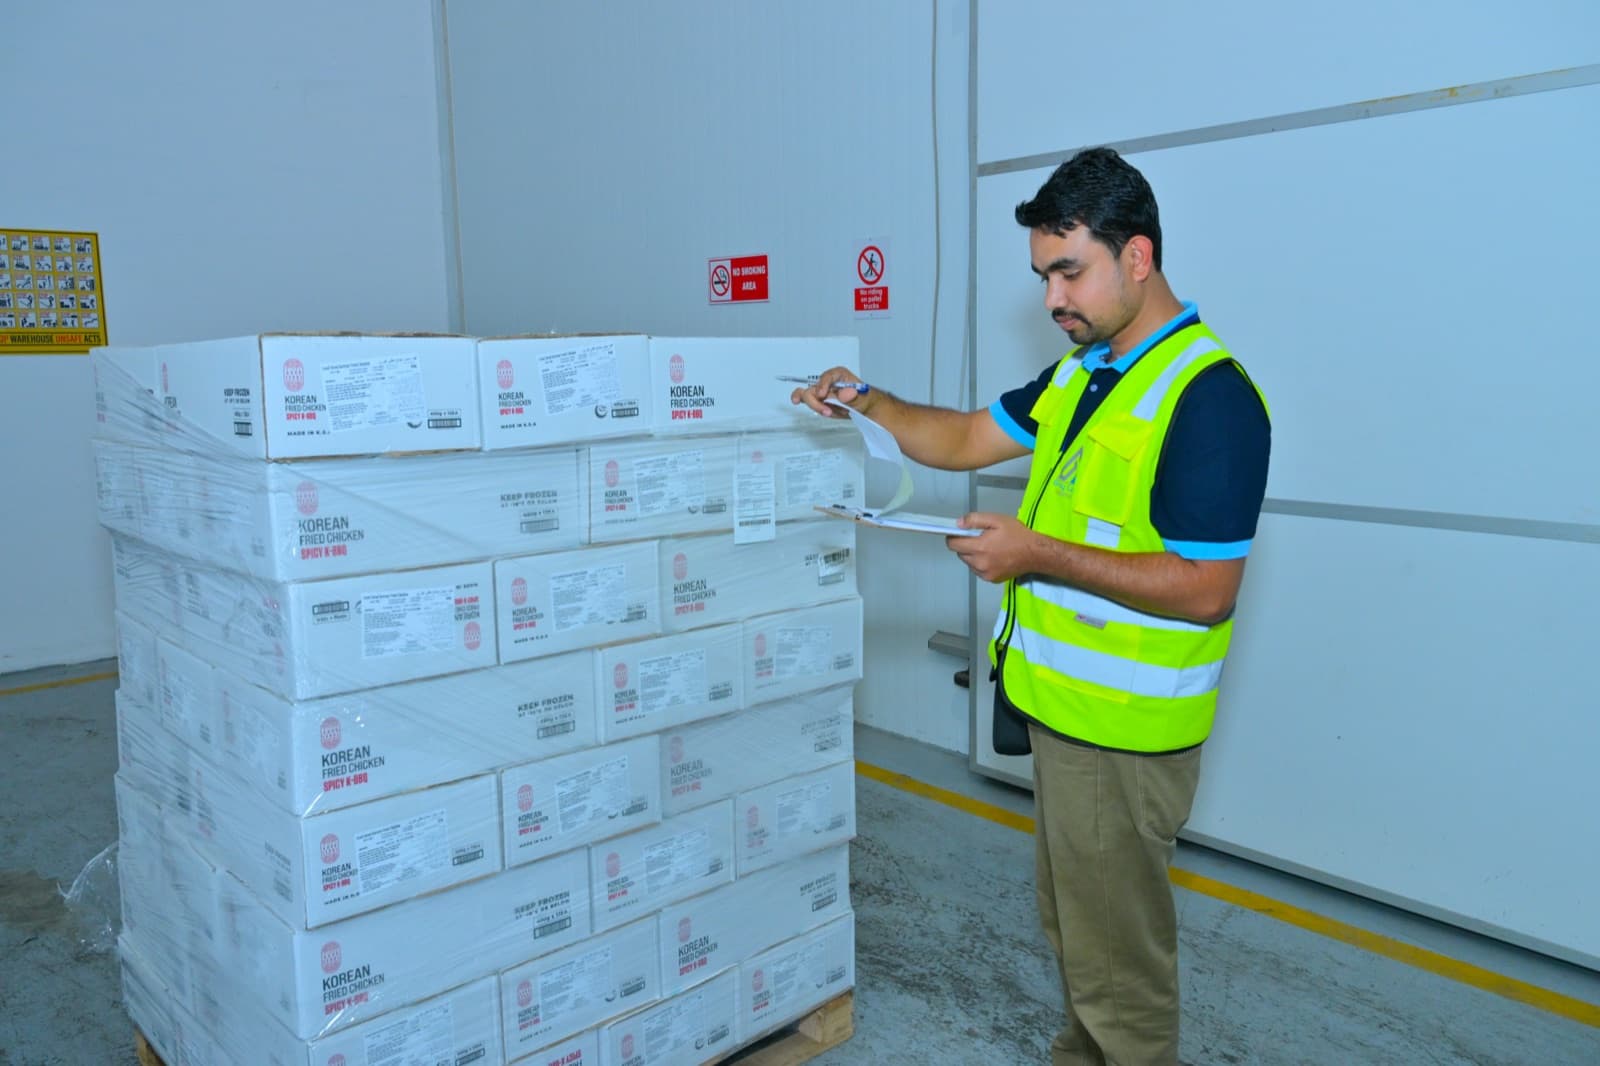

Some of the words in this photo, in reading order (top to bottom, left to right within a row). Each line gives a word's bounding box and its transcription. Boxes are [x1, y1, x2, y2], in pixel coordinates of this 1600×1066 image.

[733, 267, 740, 276] NO
[741, 265, 766, 276] SMOKING
[742, 281, 756, 291] AREA
[10, 335, 53, 343] WAREHOUSE
[56, 335, 82, 343] UNSAFE
[84, 335, 101, 343] ACTS
[498, 392, 524, 400] KOREAN
[670, 386, 704, 397] KOREAN
[285, 395, 317, 404] KOREAN
[670, 398, 688, 408] FRIED
[689, 397, 714, 407] CHICKEN
[285, 404, 300, 412] FRIED
[301, 404, 326, 412] CHICKEN
[671, 410, 686, 420] SPICY
[687, 409, 703, 419] K-BBQ
[605, 490, 627, 498] KOREAN
[299, 517, 349, 533] KOREAN
[300, 533, 325, 546] FRIED
[327, 530, 364, 543] CHICKEN
[301, 547, 322, 560] SPICY
[324, 545, 347, 558] K-BBQ
[673, 580, 706, 594] KOREAN
[674, 594, 690, 604] FRIED
[692, 589, 716, 600] CHICKEN
[512, 607, 536, 616] KOREAN
[518, 701, 539, 712] KEEP
[541, 694, 574, 706] FROZEN
[321, 745, 370, 767] KOREAN
[322, 765, 347, 779] FRIED
[348, 756, 385, 773] CHICKEN
[670, 760, 703, 777] KOREAN
[323, 778, 344, 792] SPICY
[345, 772, 368, 786] K-BBQ
[518, 810, 542, 823] KOREAN
[322, 862, 351, 876] KOREAN
[514, 902, 536, 914] KEEP
[538, 891, 570, 907] FROZEN
[678, 936, 709, 957] KOREAN
[679, 955, 693, 966] FRIED
[694, 942, 718, 960] CHICKEN
[322, 964, 370, 991] KOREAN
[323, 986, 347, 1003] FRIED
[349, 973, 385, 994] CHICKEN
[325, 999, 346, 1015] SPICY
